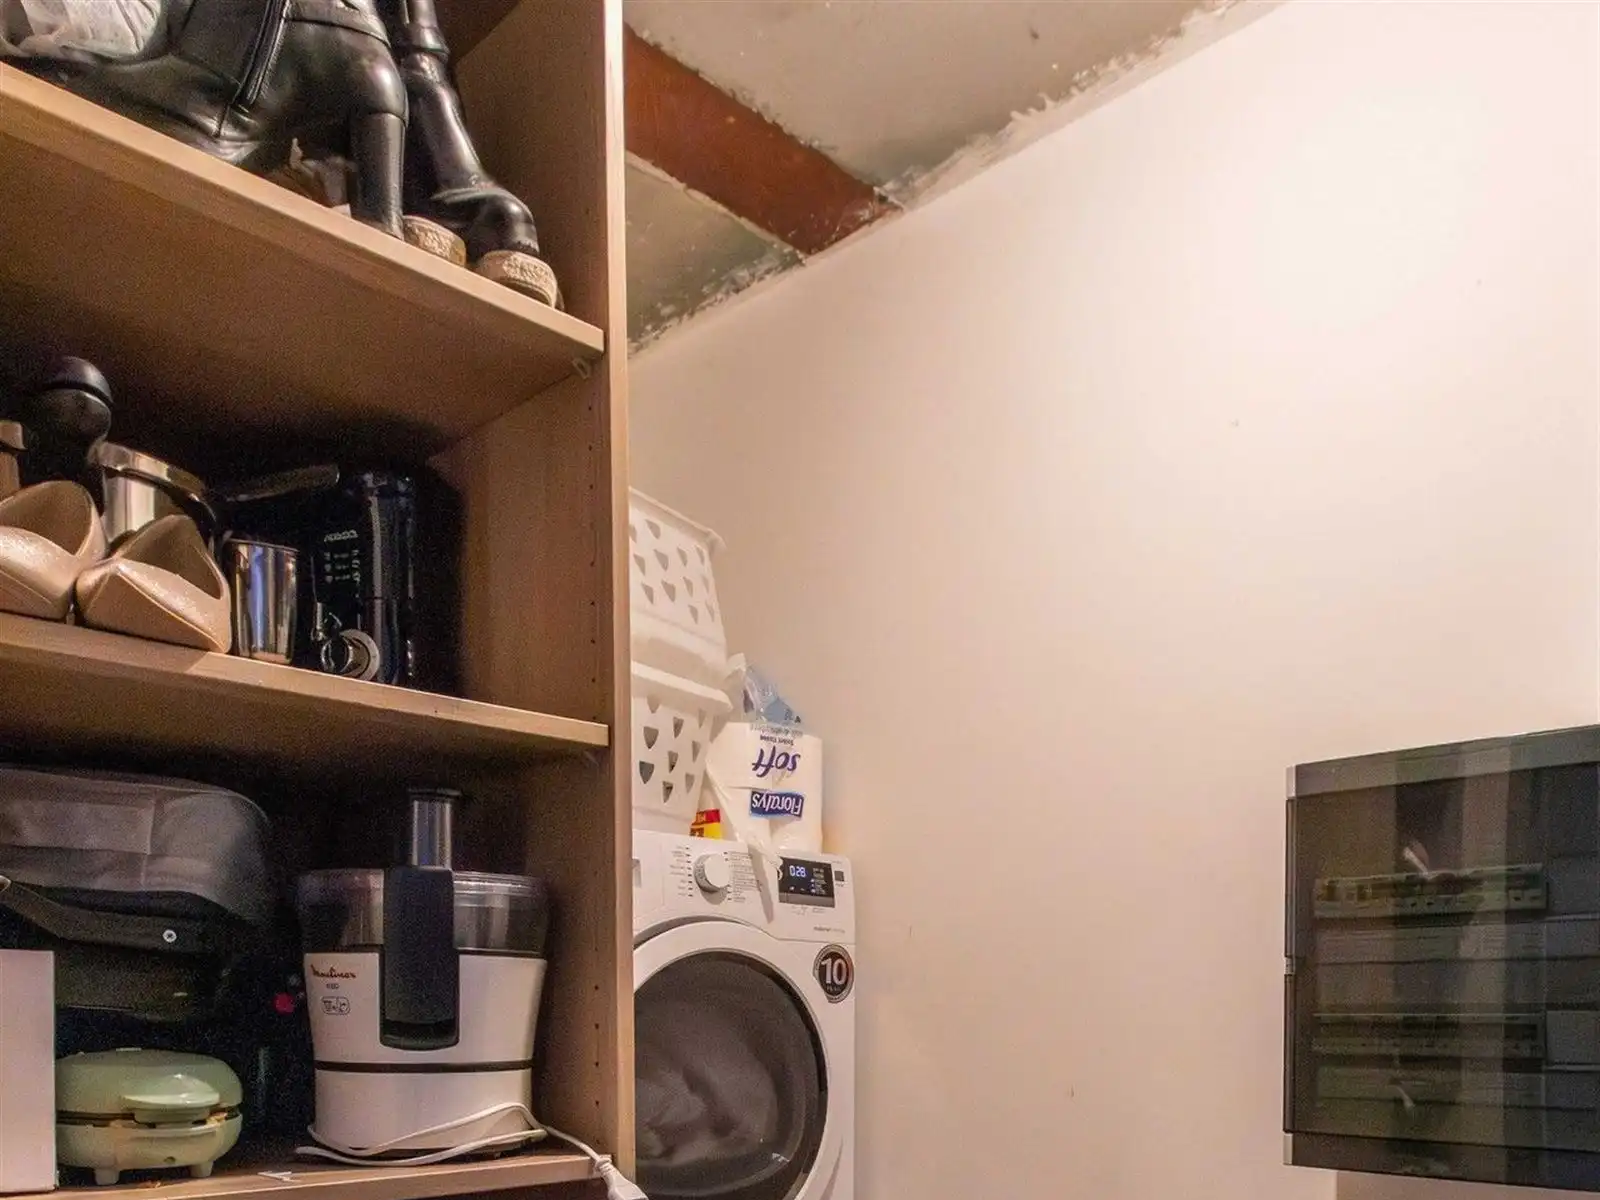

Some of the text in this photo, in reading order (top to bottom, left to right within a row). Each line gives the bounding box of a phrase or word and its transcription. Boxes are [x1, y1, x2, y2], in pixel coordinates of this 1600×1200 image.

[751, 745, 801, 778] soft
[751, 793, 802, 815] Floralys
[820, 958, 848, 985] 10
